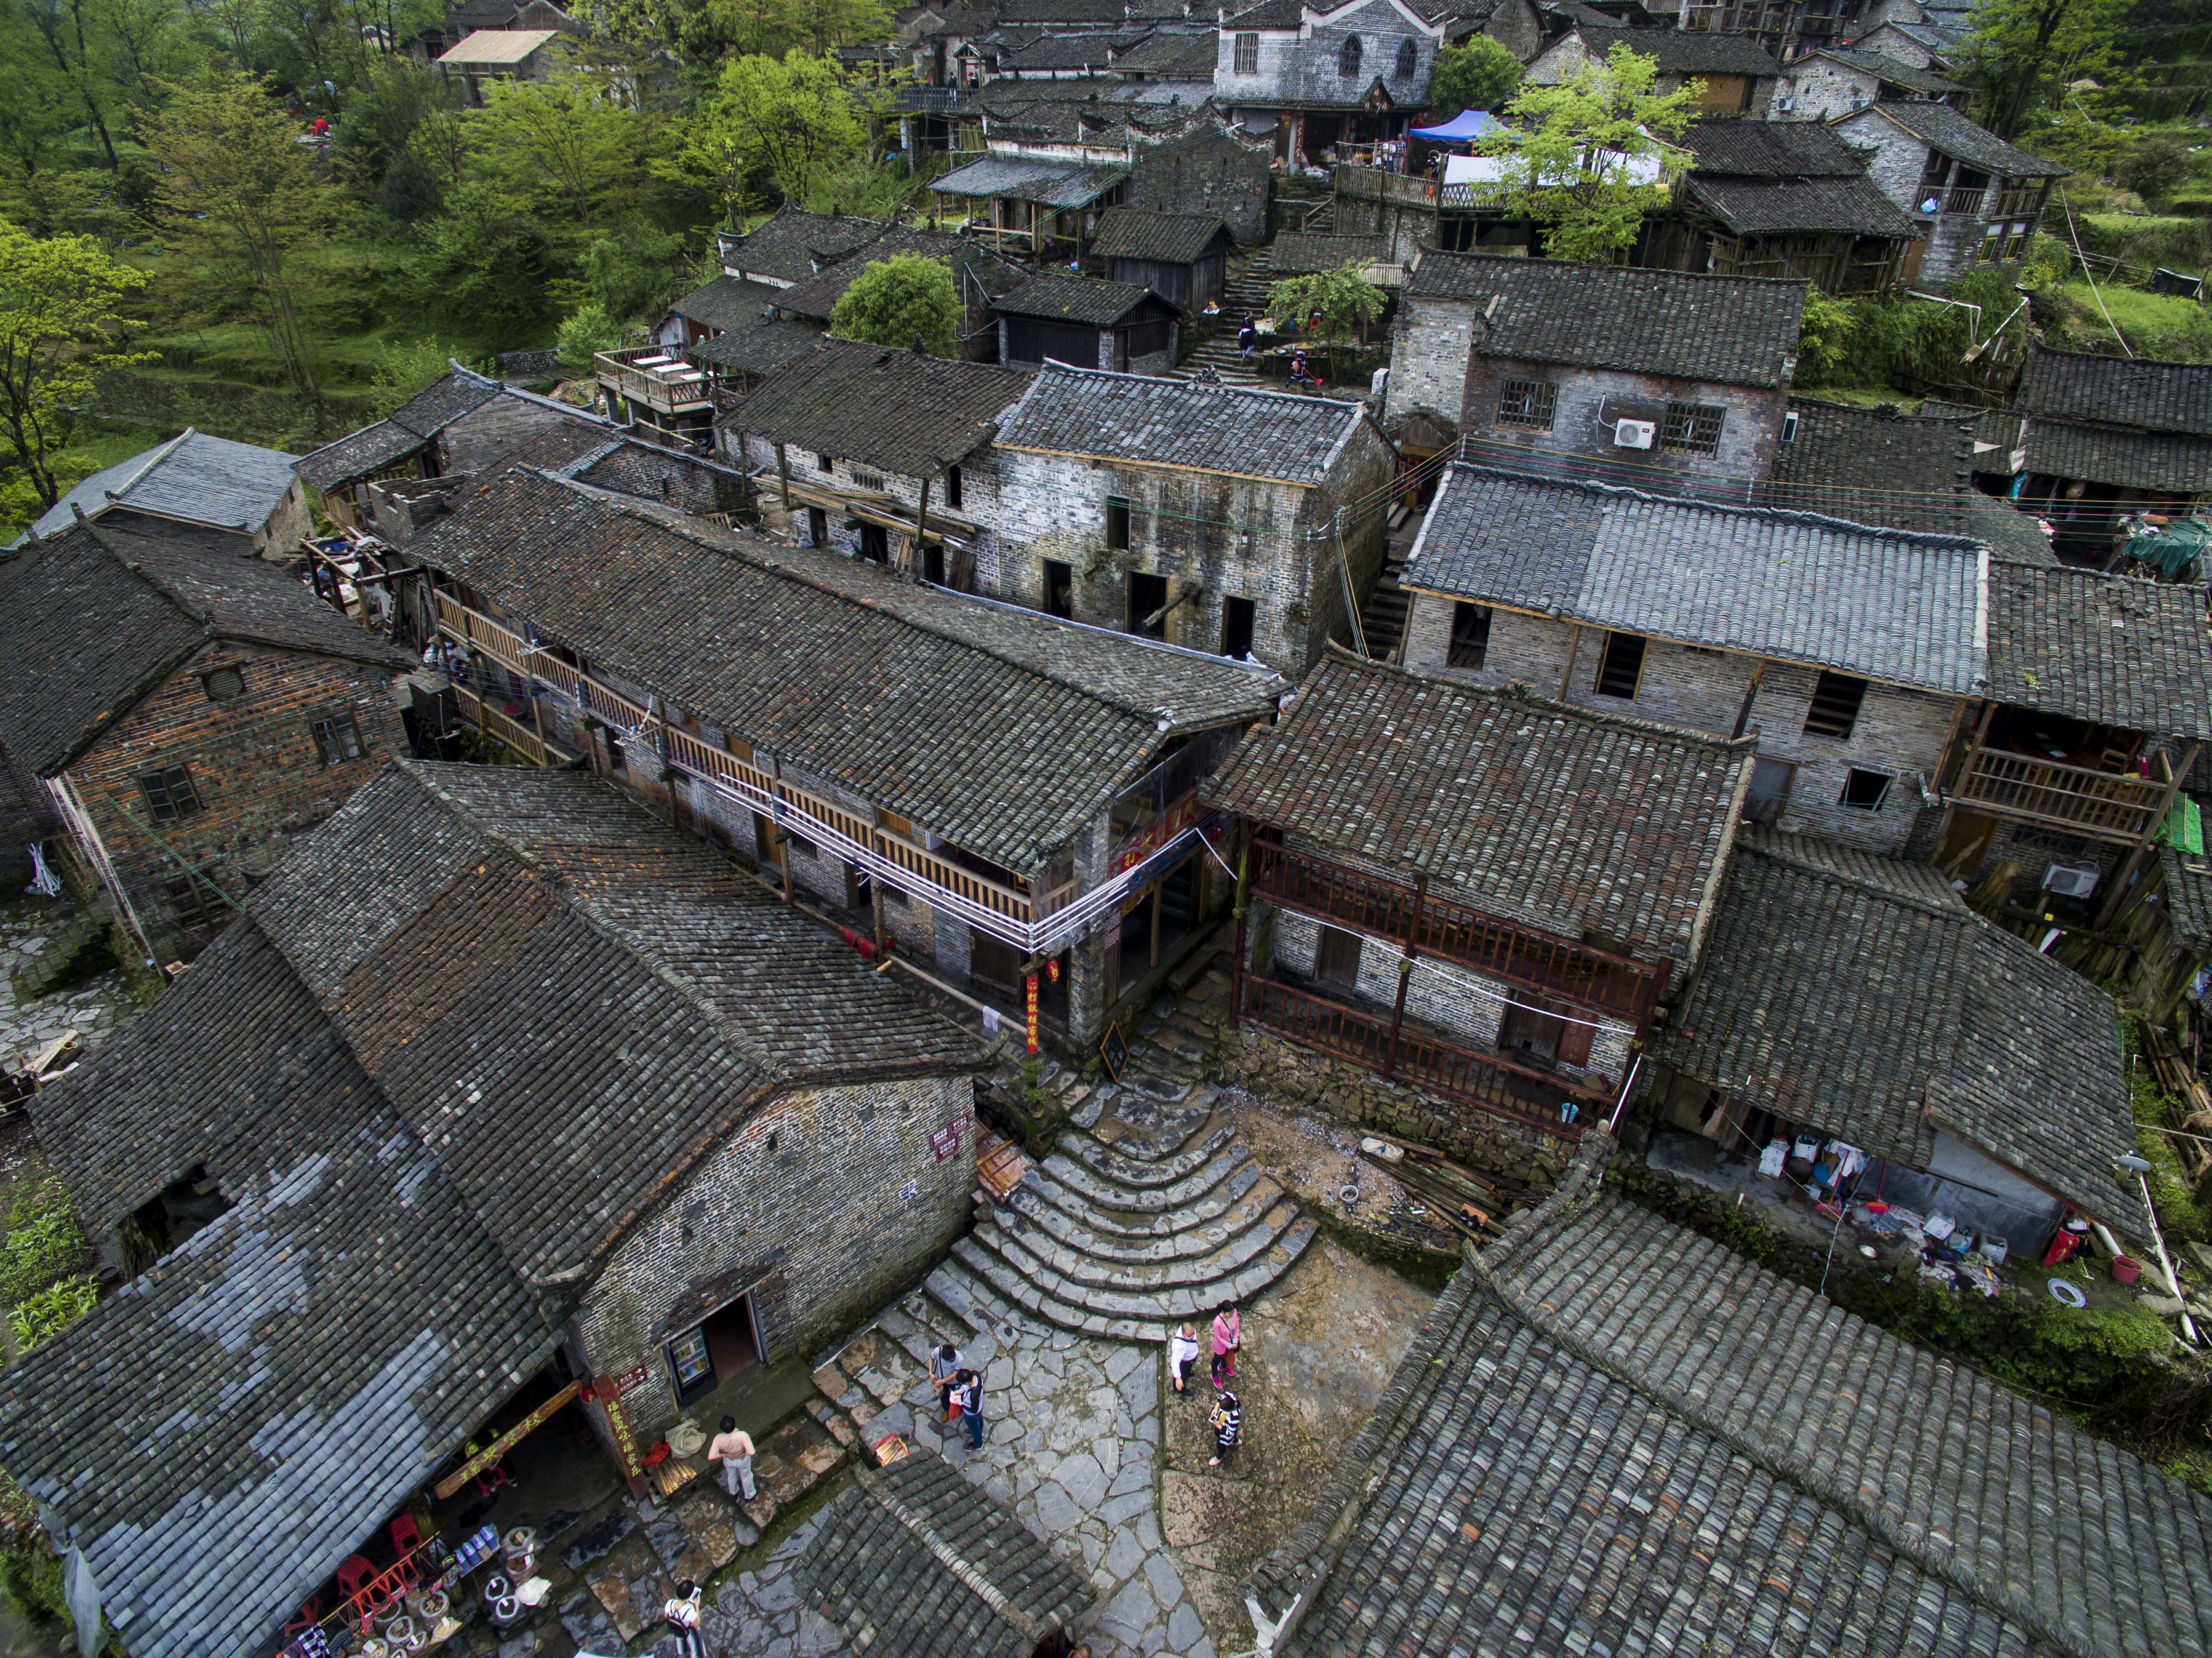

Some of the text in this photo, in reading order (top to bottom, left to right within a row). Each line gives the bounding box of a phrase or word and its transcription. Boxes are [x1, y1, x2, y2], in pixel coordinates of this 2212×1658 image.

[607, 1400, 641, 1477] 瑶家风味瑶家乐
